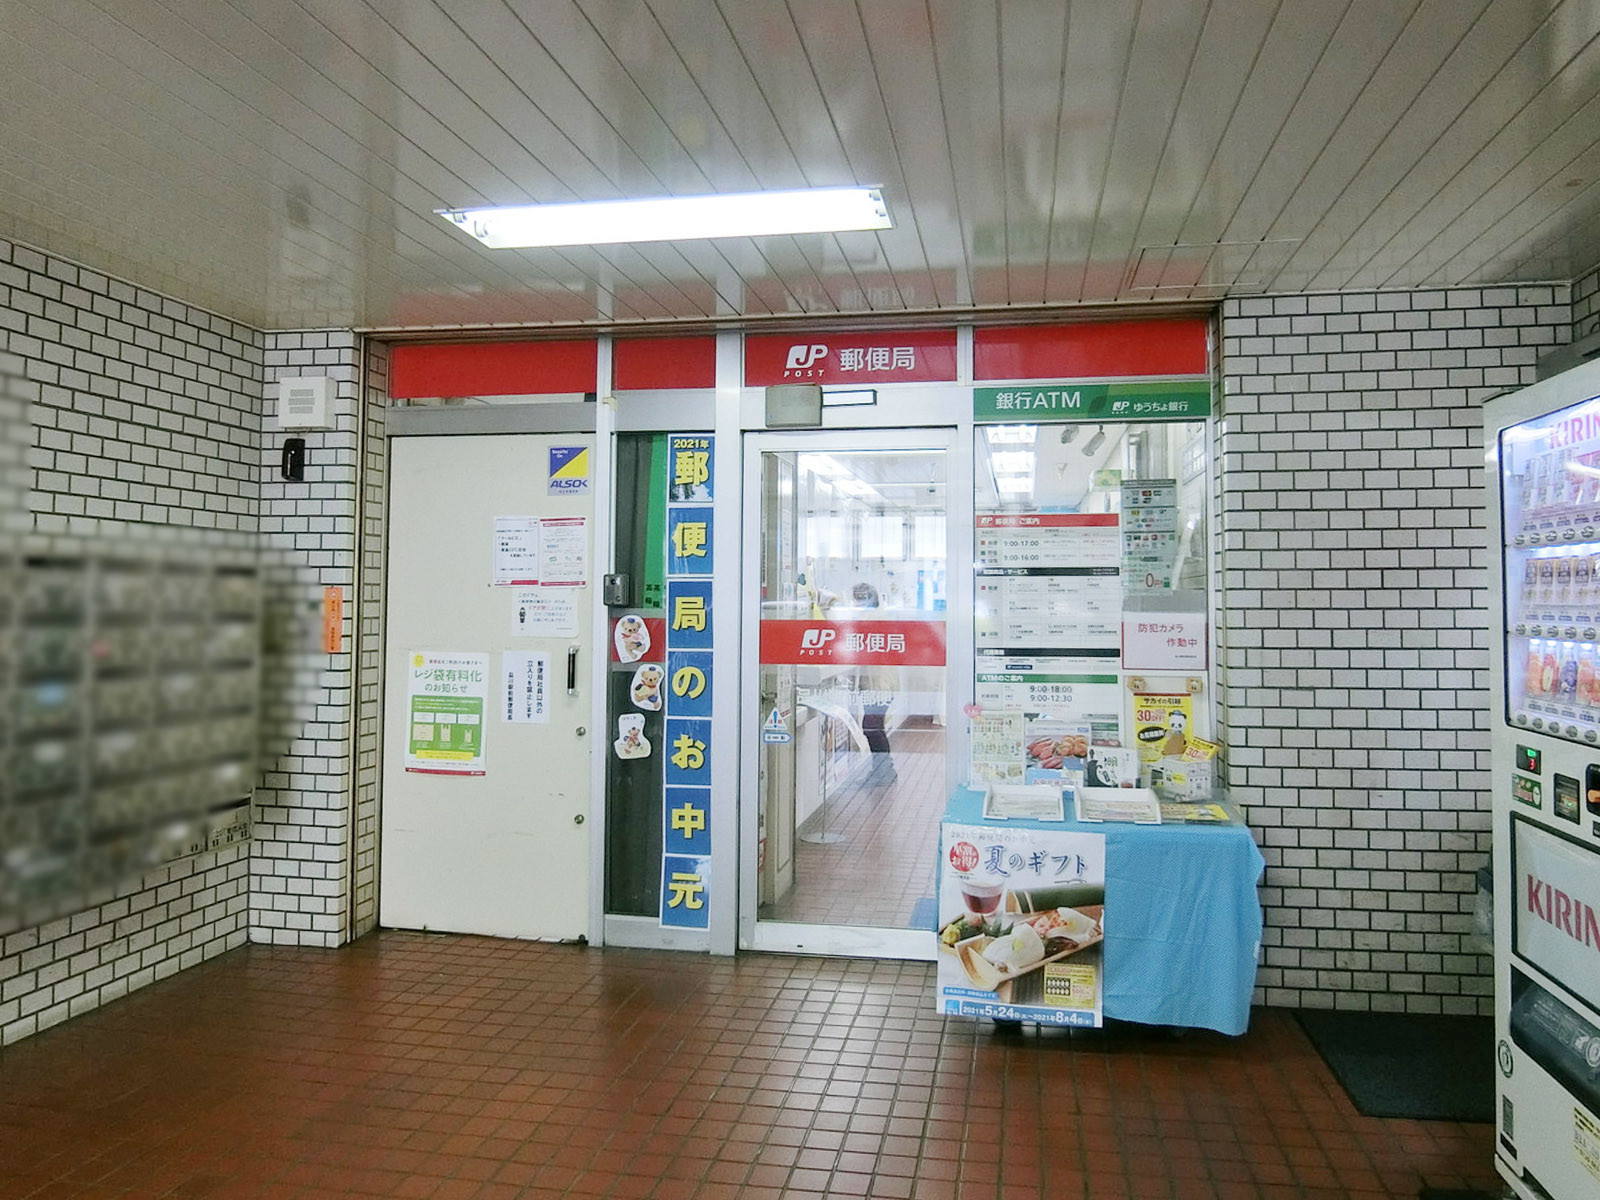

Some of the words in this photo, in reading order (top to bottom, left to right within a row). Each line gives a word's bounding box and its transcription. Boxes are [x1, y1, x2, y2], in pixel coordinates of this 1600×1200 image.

[785, 344, 829, 369] JP
[839, 346, 915, 372] 郵便局
[783, 369, 825, 378] POST
[995, 391, 1081, 410] 銀行ATM
[1133, 401, 1190, 412] ゆうちょ銀行
[673, 439, 709, 449] 2021年
[550, 479, 588, 488] ALSOK
[1137, 622, 1184, 633] 防犯カメラ
[845, 633, 906, 653] 郵便局
[1166, 637, 1197, 648] 作動中
[799, 648, 833, 656] POST
[414, 669, 483, 682] レジ袋有料化
[668, 451, 709, 910] 郵便局のお中元
[424, 683, 469, 693] のお知らせ
[1029, 685, 1073, 693] 9:00-18:00
[1029, 694, 1073, 702] 9:00-12:30
[984, 844, 1087, 877] 夏のギフト
